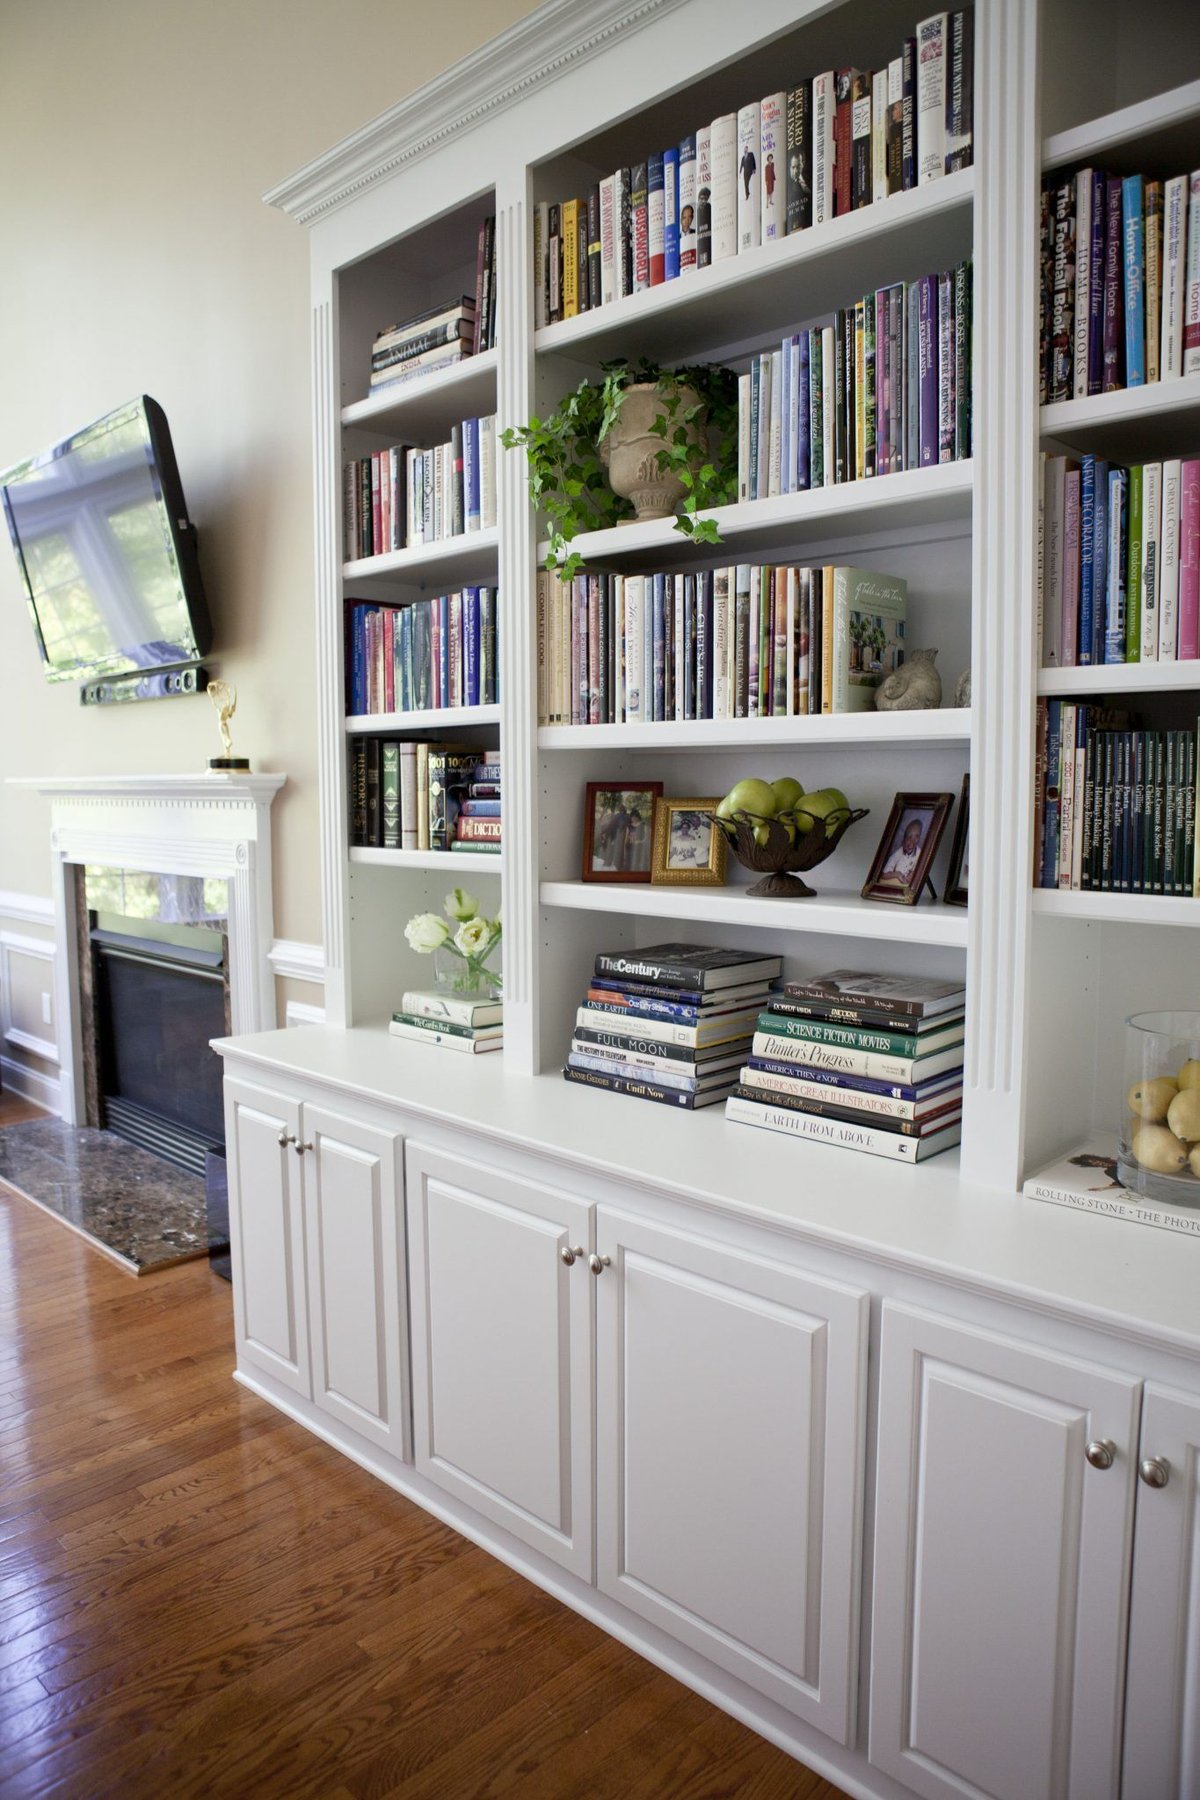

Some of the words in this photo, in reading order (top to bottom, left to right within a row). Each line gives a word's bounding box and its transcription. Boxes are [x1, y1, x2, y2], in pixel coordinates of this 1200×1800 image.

[788, 91, 797, 105] M.
[903, 96, 912, 115] EYES
[787, 107, 796, 151] NIXON
[795, 88, 803, 147] RICHARD
[854, 106, 862, 135] LION
[861, 102, 870, 131] LAST
[903, 138, 912, 159] PRIZE
[602, 184, 612, 206] BOB
[1056, 185, 1069, 219] The
[1110, 188, 1121, 209] The
[602, 204, 614, 263] WOODWARD
[1109, 211, 1119, 239] New
[1147, 220, 1157, 257] YOUR
[635, 207, 647, 283] BUSHWORLD
[1054, 220, 1068, 291] Football
[1126, 217, 1140, 265] Home
[1077, 248, 1090, 300] HOME
[1107, 240, 1119, 279] Family
[1147, 257, 1157, 290] HOME
[956, 266, 965, 308] VISIONS
[1107, 281, 1119, 318] Home
[1126, 264, 1140, 311] Office
[1190, 282, 1200, 322] home
[1053, 293, 1067, 337] Book
[1091, 291, 1102, 317] Home
[942, 312, 950, 335] Book
[956, 314, 965, 345] ROSES
[388, 338, 430, 364] ANIMAL
[918, 319, 927, 380] HOUSEPLANTS
[942, 341, 950, 375] FLOWER
[1076, 318, 1088, 376] BOOKS
[400, 359, 422, 372] INDIA
[1057, 353, 1065, 381] Sports
[811, 379, 820, 405] child's
[941, 376, 950, 428] GARDENING
[811, 406, 820, 440] garden
[1082, 458, 1095, 490] NEW
[1147, 475, 1155, 505] FORMAL
[1167, 477, 1177, 515] FORMAL
[1080, 493, 1095, 565] DECORATOR
[1096, 505, 1104, 555] SEASONS
[1147, 504, 1155, 540] COUNTRY
[1050, 534, 1058, 552] New
[1165, 516, 1176, 568] COUNTRY
[1049, 552, 1058, 576] French
[1131, 540, 1141, 583] Outdoor
[861, 582, 877, 596] Table
[716, 601, 727, 650] Roasting
[1129, 583, 1138, 637] ENTERTAINING
[697, 612, 706, 661] CHEF'S
[737, 623, 745, 641] BON
[697, 661, 705, 687] ART
[1050, 733, 1059, 757] Table
[428, 756, 446, 769] 1001
[1049, 757, 1058, 777] Style
[1064, 761, 1073, 778] 200
[357, 753, 366, 809] HISTORY
[1083, 780, 1093, 811] Holiday
[1114, 784, 1123, 800] Pies
[1093, 786, 1103, 816] Holiday
[1102, 786, 1111, 830] Thanksgiving
[1122, 786, 1131, 809] Pasta
[1134, 784, 1143, 814] Grilling
[1145, 784, 1154, 815] Chicken
[1155, 798, 1163, 824] Creams
[1177, 786, 1186, 830] Vegetarian
[1185, 787, 1194, 819] Cooking
[1062, 797, 1073, 832] Panini
[1114, 808, 1123, 827] Tarts
[1060, 833, 1069, 863] Recipes
[1083, 811, 1093, 859] Entertaining
[1093, 818, 1103, 847] Baking
[1155, 833, 1163, 859] Sorbets
[1185, 820, 1194, 846] Basics
[1102, 837, 1111, 870] Christmas
[587, 1000, 602, 1011] ONE
[603, 1002, 628, 1015] EARTH
[413, 1017, 422, 1027] The
[421, 1019, 439, 1030] Garden
[439, 1023, 451, 1034] Book
[786, 1021, 822, 1040] SCIENCE
[823, 1027, 857, 1045] FICTION
[858, 1031, 891, 1051] MOVIES
[597, 1033, 624, 1049] FULL
[628, 1040, 668, 1057] MOON
[605, 1050, 627, 1062] TELEVISION
[763, 1036, 808, 1061] Painter's
[808, 1044, 856, 1070] Progress
[569, 1070, 586, 1082] ANNE
[586, 1074, 609, 1087] GEDDES
[626, 1082, 646, 1096] Until
[646, 1086, 665, 1100] Now
[795, 1069, 815, 1080] THEN
[821, 1073, 840, 1085] NOW
[742, 1089, 755, 1099] Day
[762, 1093, 772, 1101] the
[772, 1095, 782, 1104] Life
[790, 1098, 823, 1114] Hollywood
[755, 1075, 800, 1093] AMERICA'S
[800, 1083, 829, 1099] GREAT
[830, 1088, 894, 1114] ILLUSTRATORS
[764, 1112, 800, 1131] EARTH
[801, 1117, 835, 1138] FROM
[837, 1126, 874, 1147] ABOVE
[1035, 1186, 1085, 1207] ROLLING
[1087, 1199, 1126, 1215] STONE
[1135, 1209, 1161, 1223] THE
[1164, 1216, 1200, 1232] PHOTO
